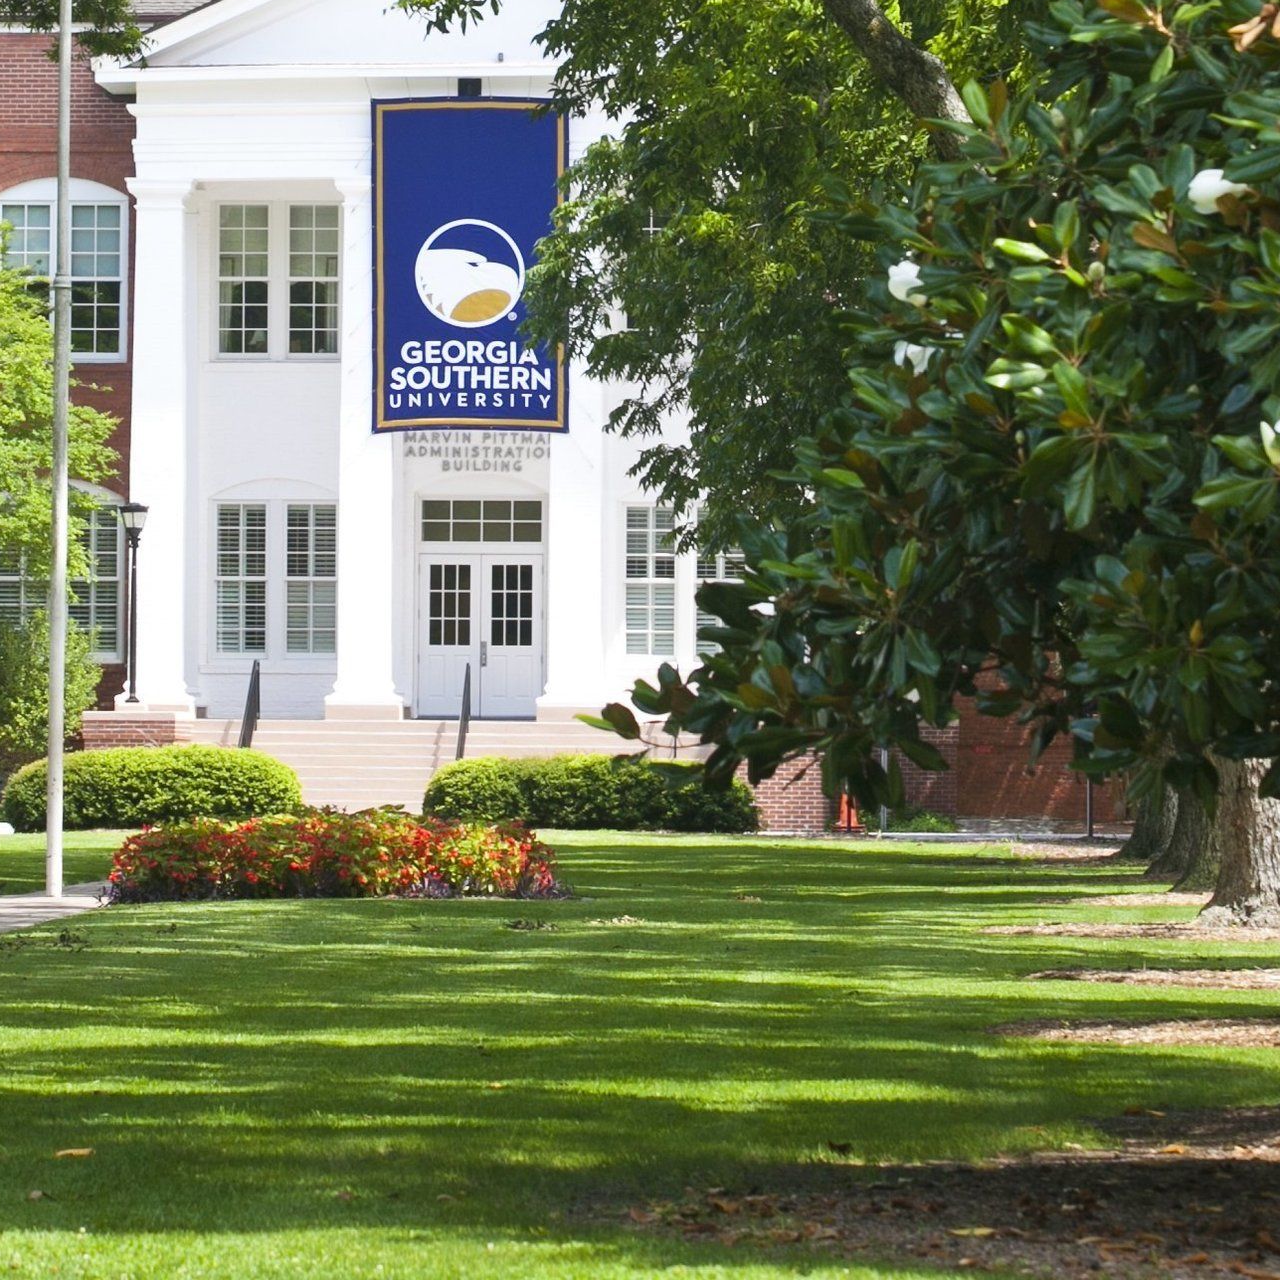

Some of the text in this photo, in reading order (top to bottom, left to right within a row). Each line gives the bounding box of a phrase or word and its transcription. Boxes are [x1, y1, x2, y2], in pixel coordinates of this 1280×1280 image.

[401, 340, 539, 365] GEORGIA
[390, 366, 552, 390] SOUTHERN
[389, 392, 551, 409] UNIVERSITY
[404, 432, 550, 445] MARVIN PITTMA
[404, 446, 550, 459] ADMINISTRATIO
[442, 460, 523, 472] BUILDING
